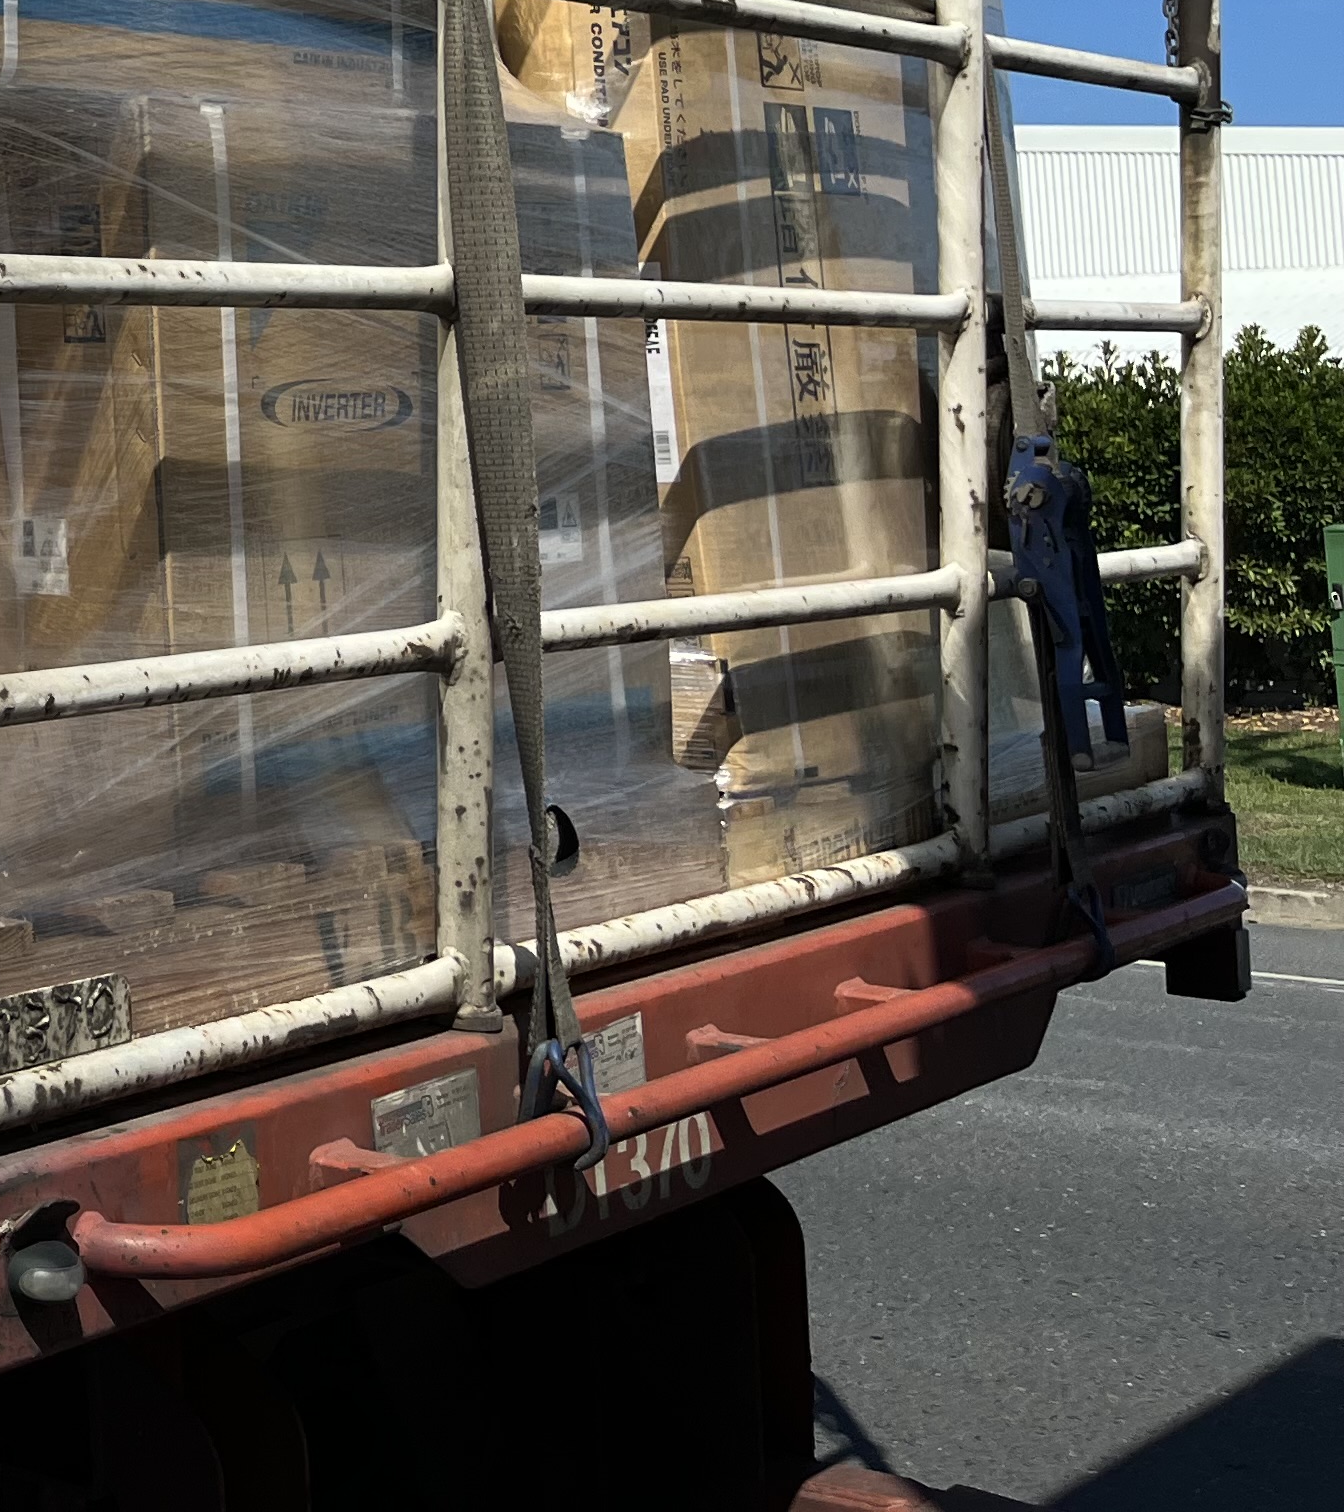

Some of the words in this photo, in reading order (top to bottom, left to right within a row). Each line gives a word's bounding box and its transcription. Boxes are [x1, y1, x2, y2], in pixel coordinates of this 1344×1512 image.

[658, 52, 669, 76] USE
[660, 79, 670, 104] PAD
[661, 107, 673, 149] UNDER
[291, 391, 388, 423] INVERTER
